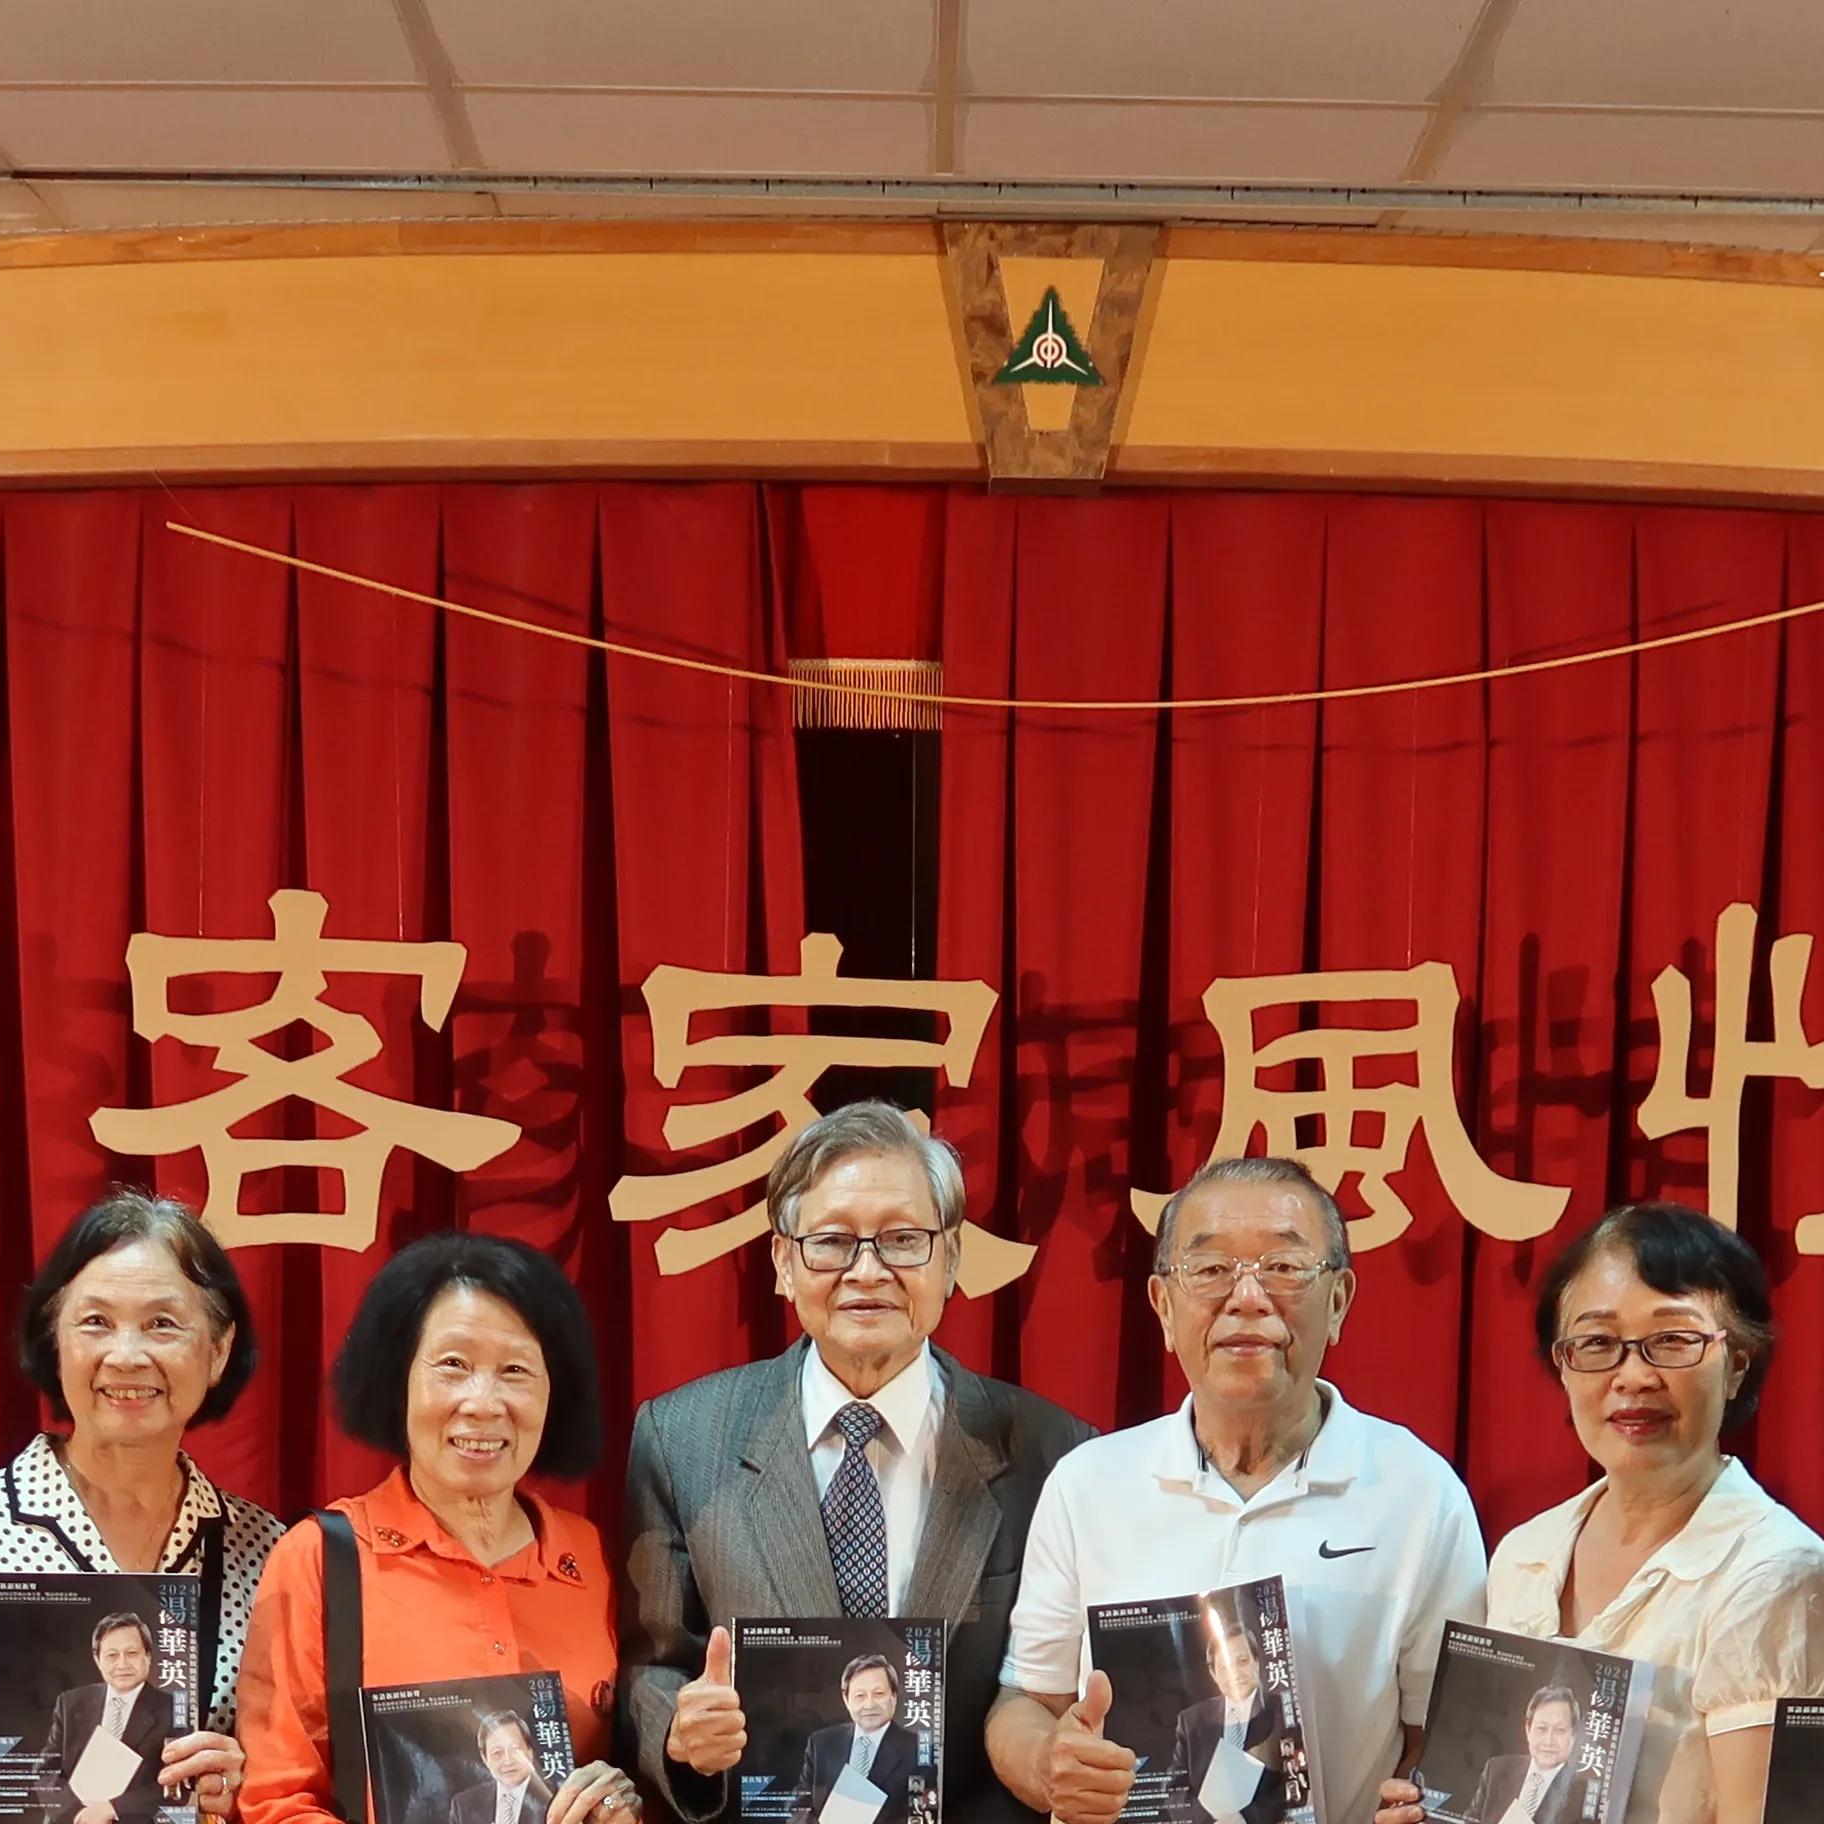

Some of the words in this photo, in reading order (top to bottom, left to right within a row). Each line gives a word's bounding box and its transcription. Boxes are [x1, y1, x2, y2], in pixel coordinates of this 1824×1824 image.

[158, 1584, 197, 1597] 2024
[905, 1627, 942, 1638] 2024
[1595, 1663, 1630, 1679] 2024
